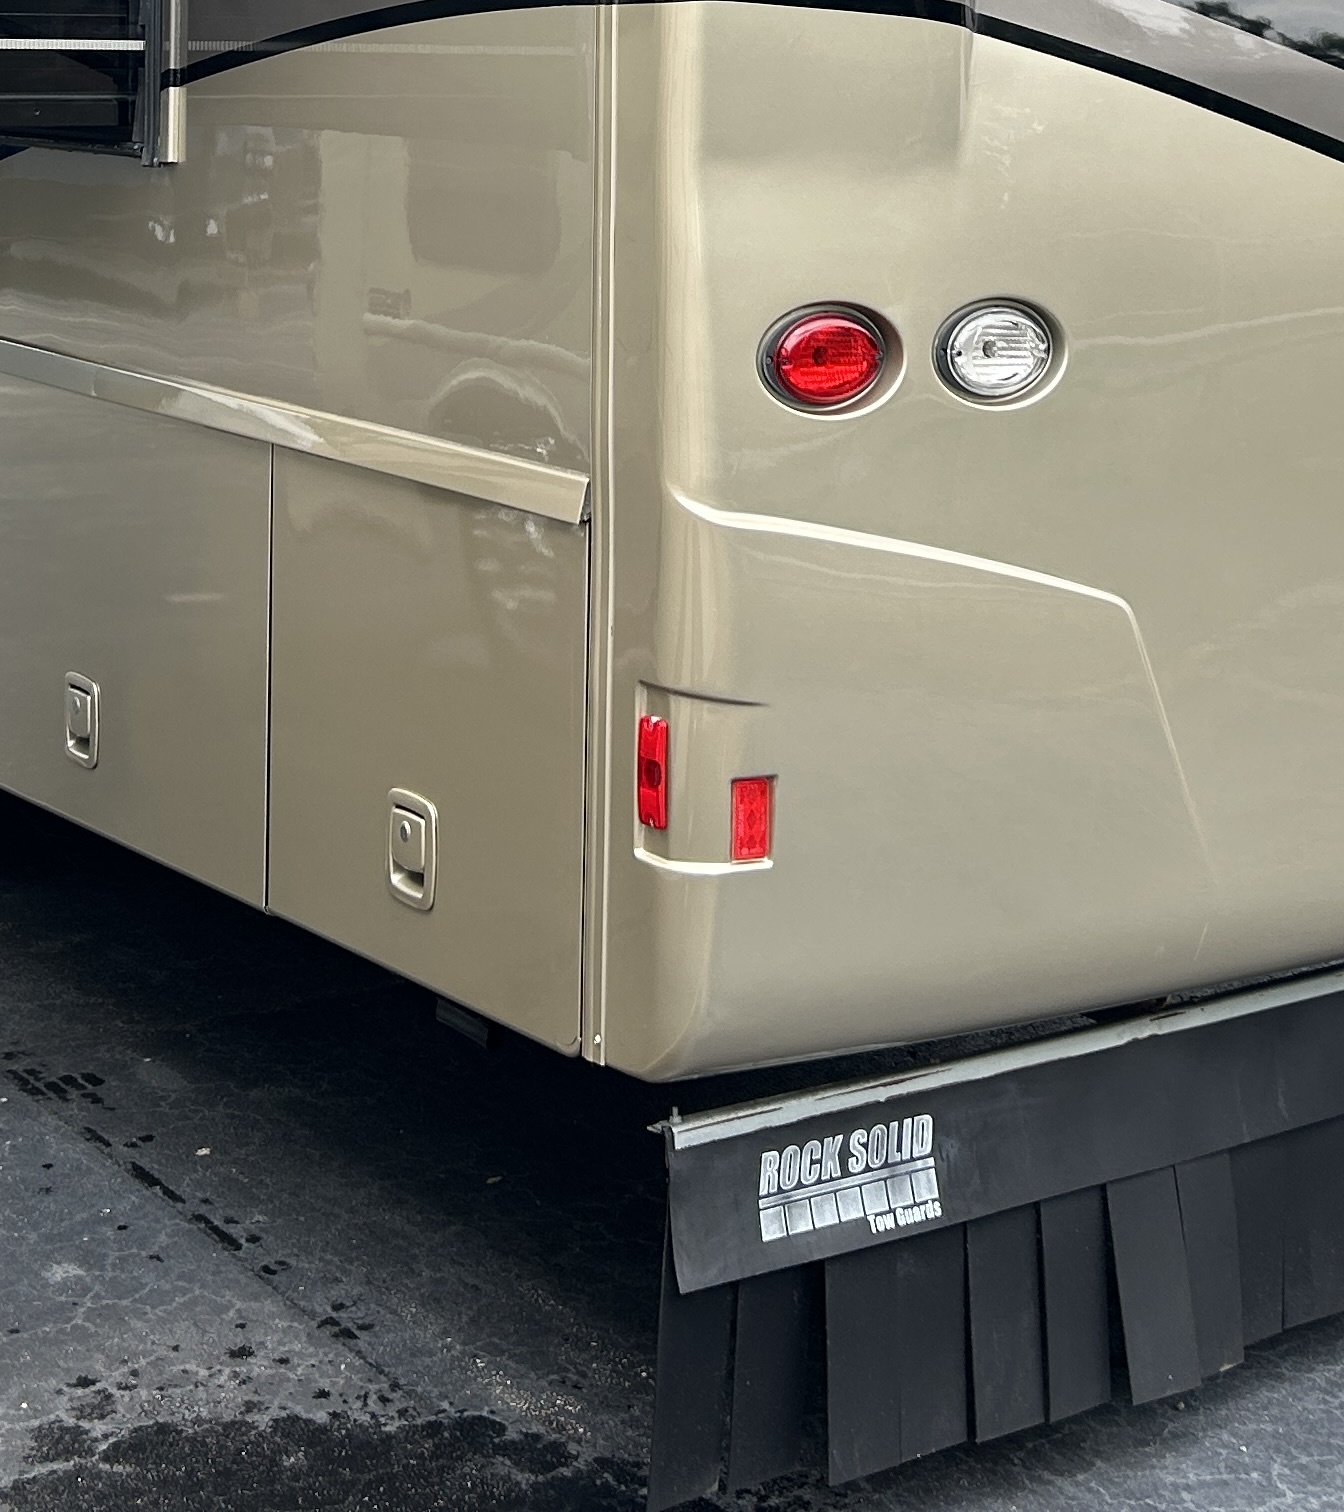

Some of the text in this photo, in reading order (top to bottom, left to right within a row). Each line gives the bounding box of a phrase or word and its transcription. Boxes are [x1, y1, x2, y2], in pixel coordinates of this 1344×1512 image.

[759, 1114, 933, 1196] ROCK SOLID
[867, 1199, 943, 1234] Tow Guards
